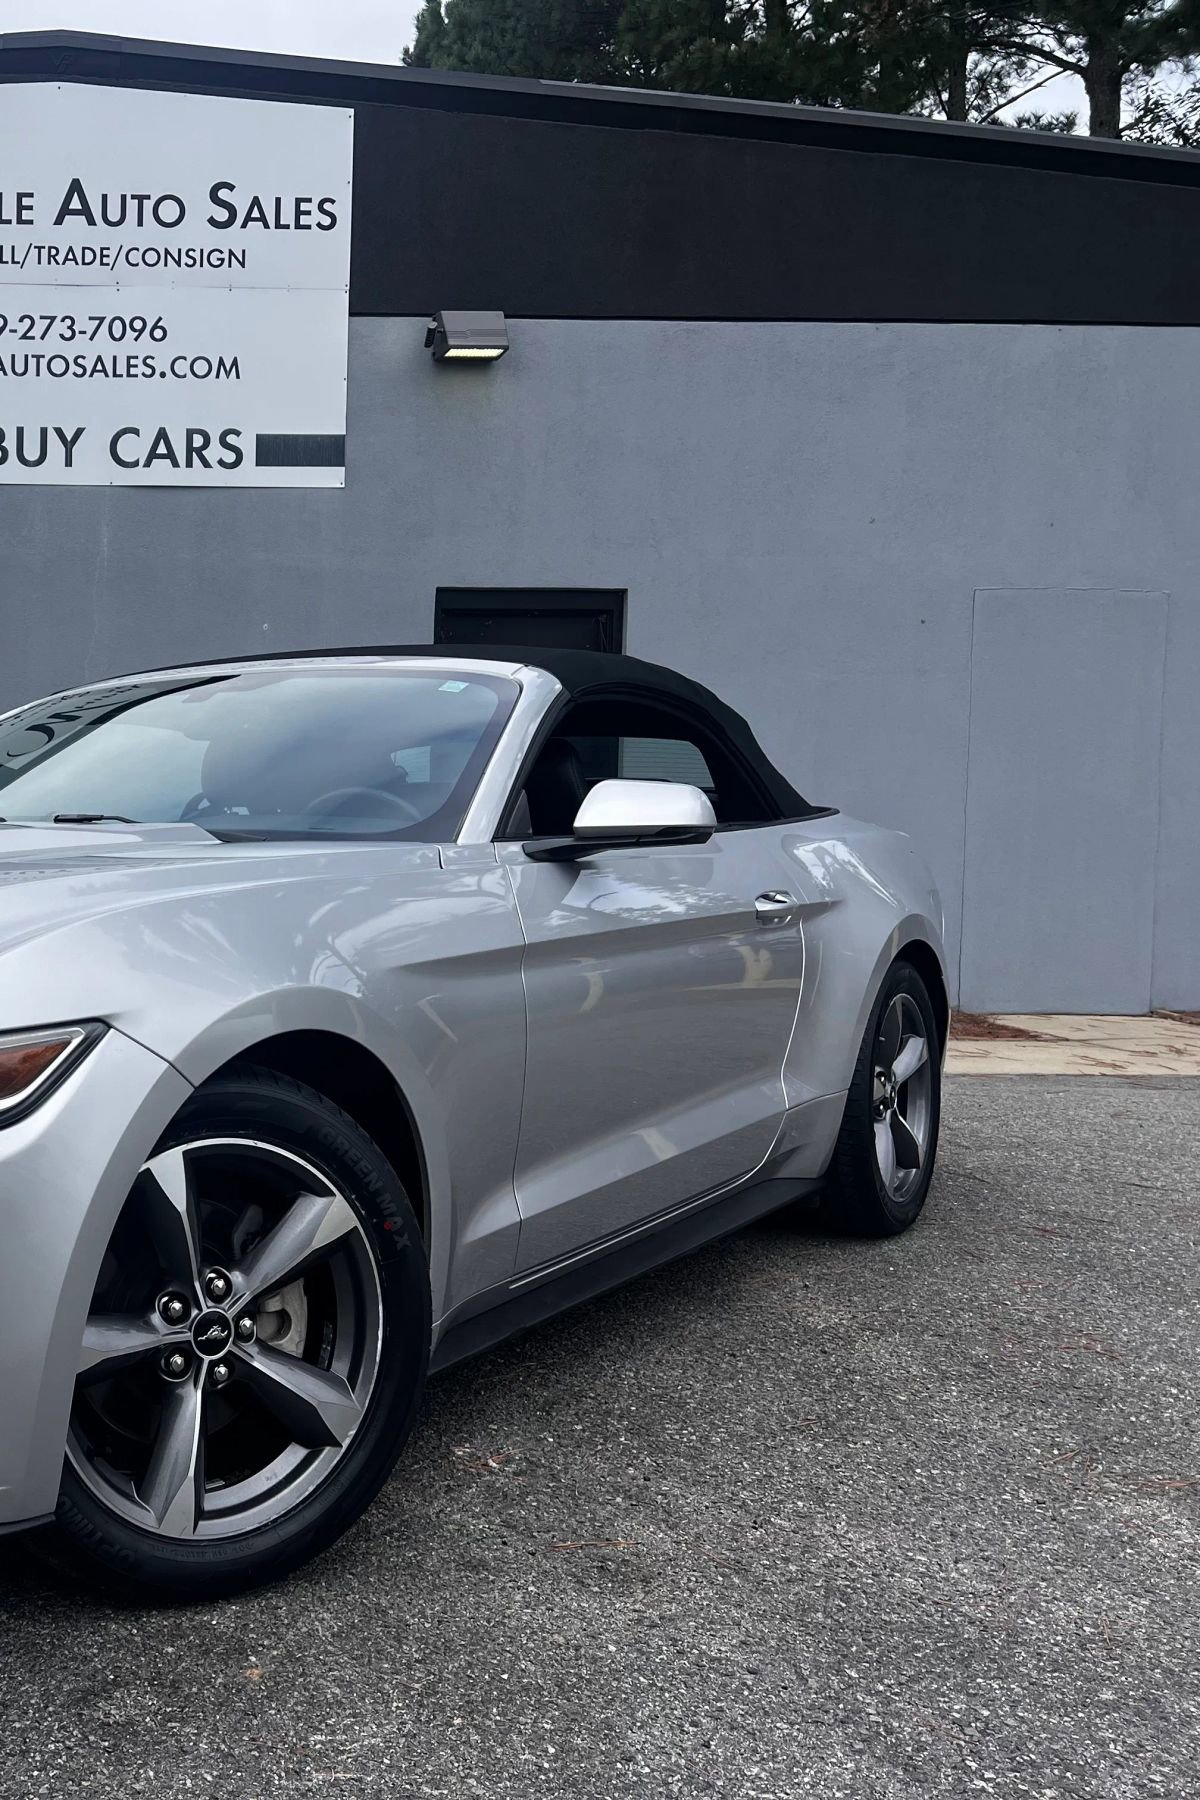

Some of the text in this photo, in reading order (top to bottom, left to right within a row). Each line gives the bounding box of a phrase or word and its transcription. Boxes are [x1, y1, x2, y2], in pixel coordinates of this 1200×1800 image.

[52, 177, 186, 229] AUTO
[206, 181, 338, 232] SALES
[109, 426, 244, 470] CARS
[317, 1124, 413, 1252] GREEN MAX
